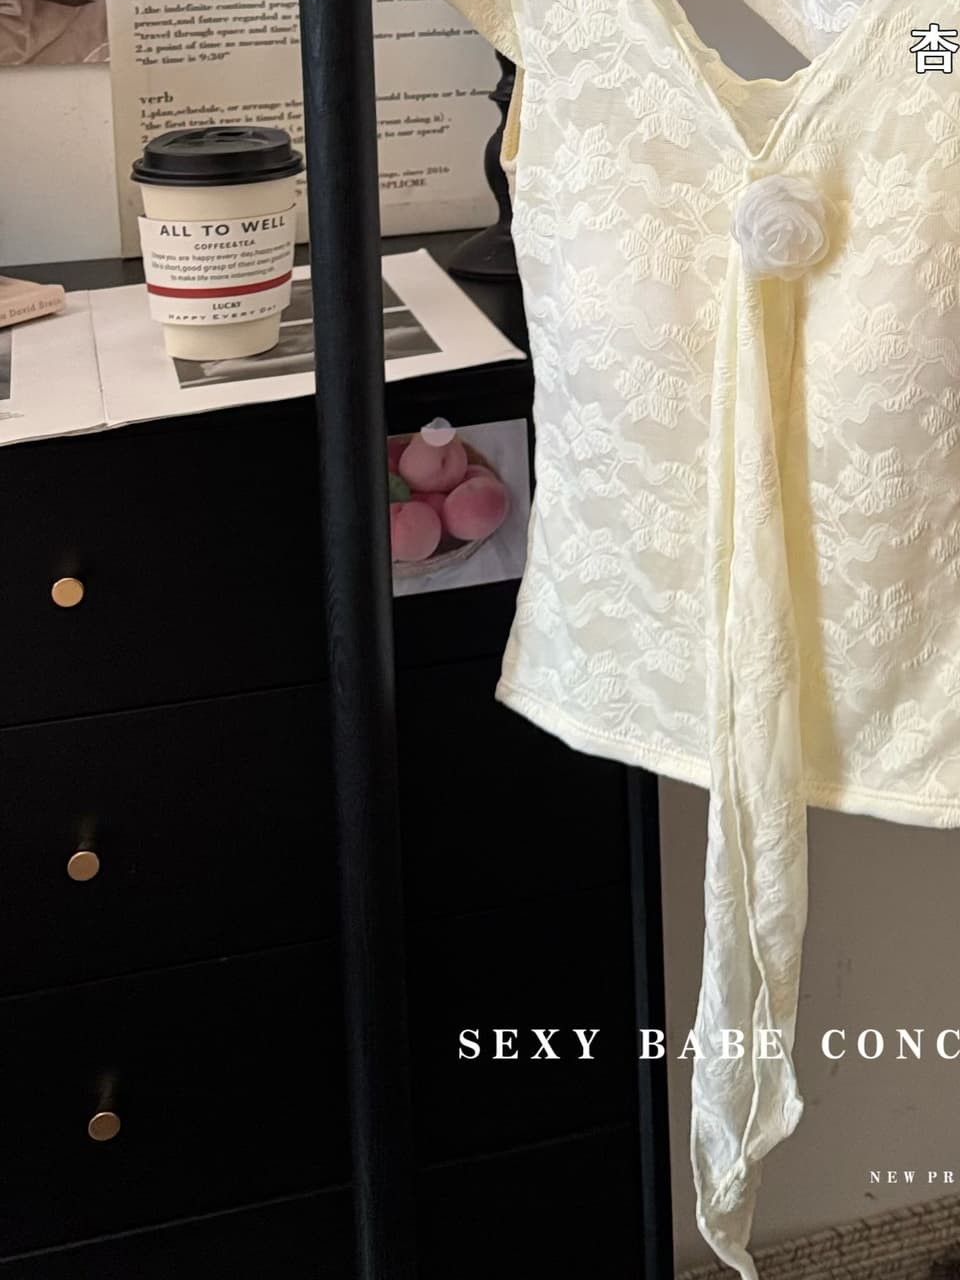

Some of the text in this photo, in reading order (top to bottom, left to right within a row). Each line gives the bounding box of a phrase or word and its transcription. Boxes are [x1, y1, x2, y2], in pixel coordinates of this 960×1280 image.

[139, 91, 174, 104] verb
[160, 216, 286, 237] ALL TO WELL
[10, 303, 36, 317] David
